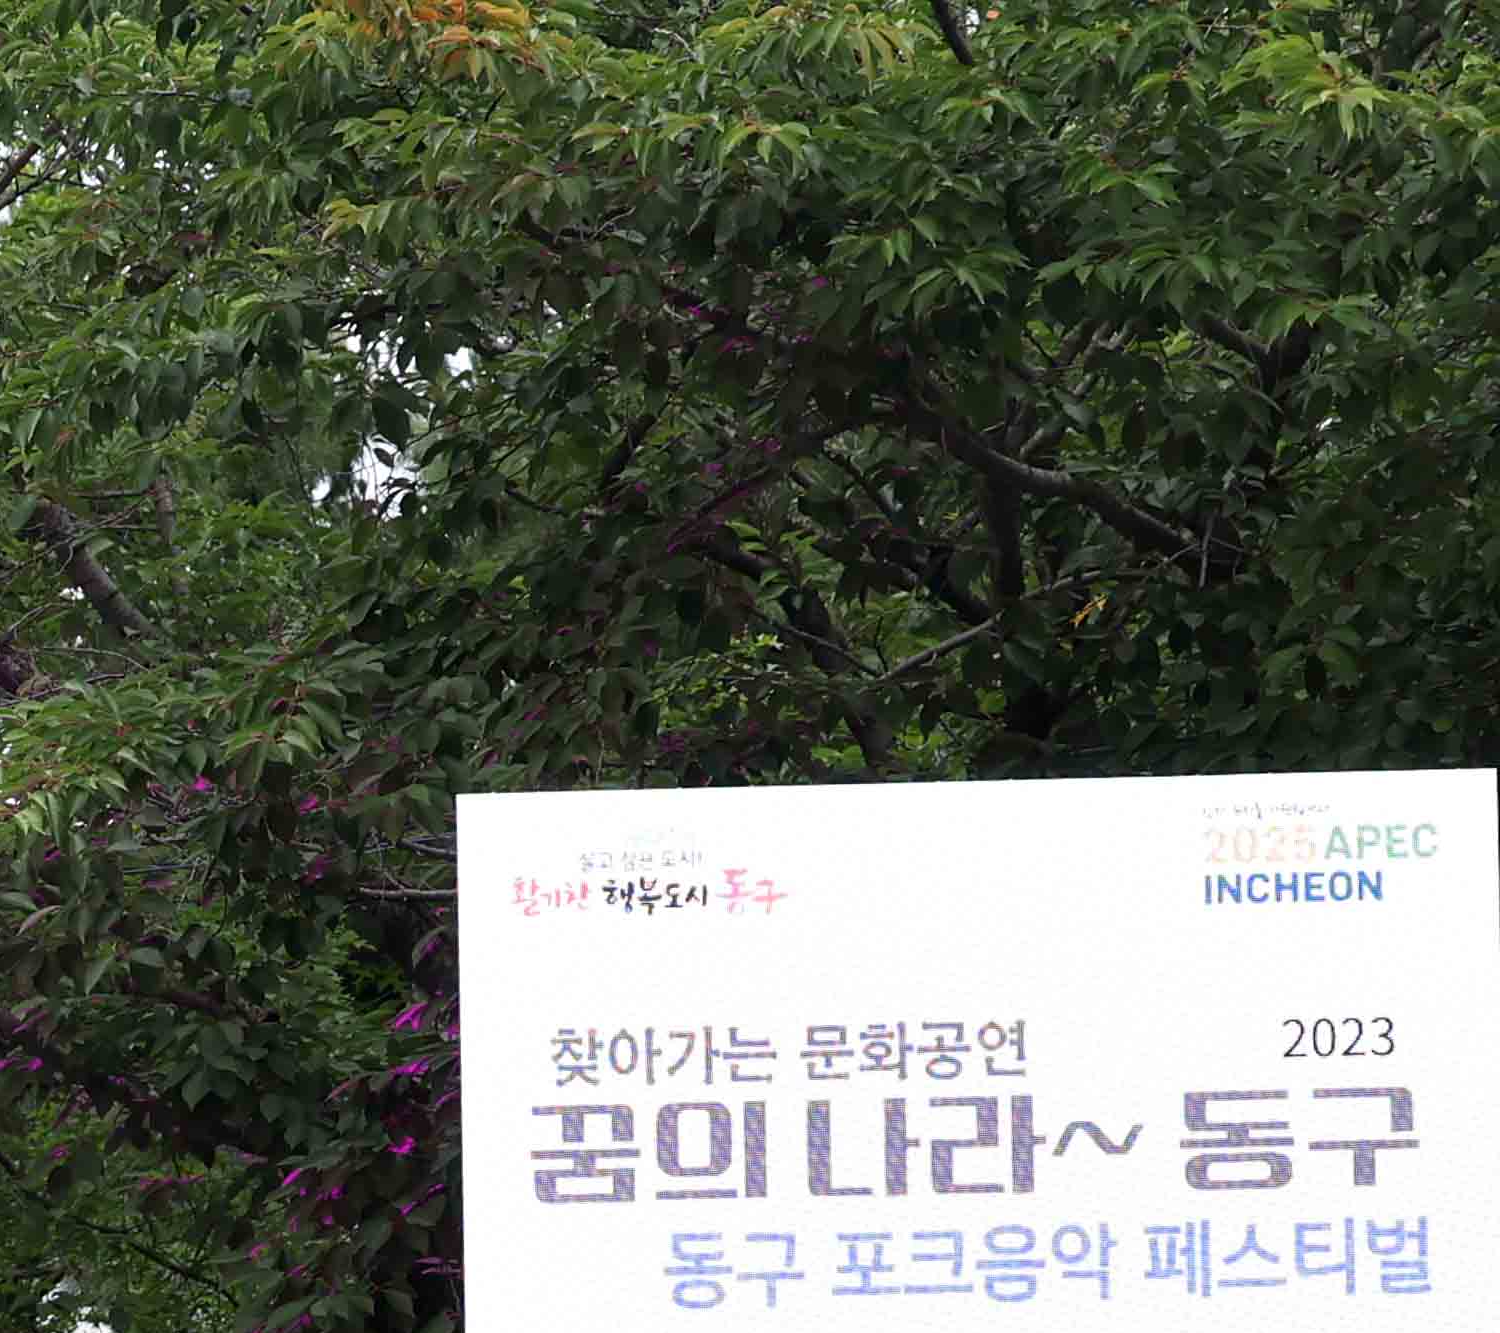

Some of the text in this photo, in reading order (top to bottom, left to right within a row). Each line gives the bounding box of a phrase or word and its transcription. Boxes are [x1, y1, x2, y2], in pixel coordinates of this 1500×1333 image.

[1324, 823, 1438, 859] APEC
[601, 876, 708, 915] 행복도시
[1204, 870, 1383, 904] INCHEON
[550, 1019, 1029, 1086] 찾아가는 문화공연
[1281, 1016, 1397, 1059] 2023
[530, 1099, 767, 1204] 꿈의
[1180, 1086, 1421, 1191] 동구
[662, 1216, 1434, 1310] 동구 포크음악 페스티벌
